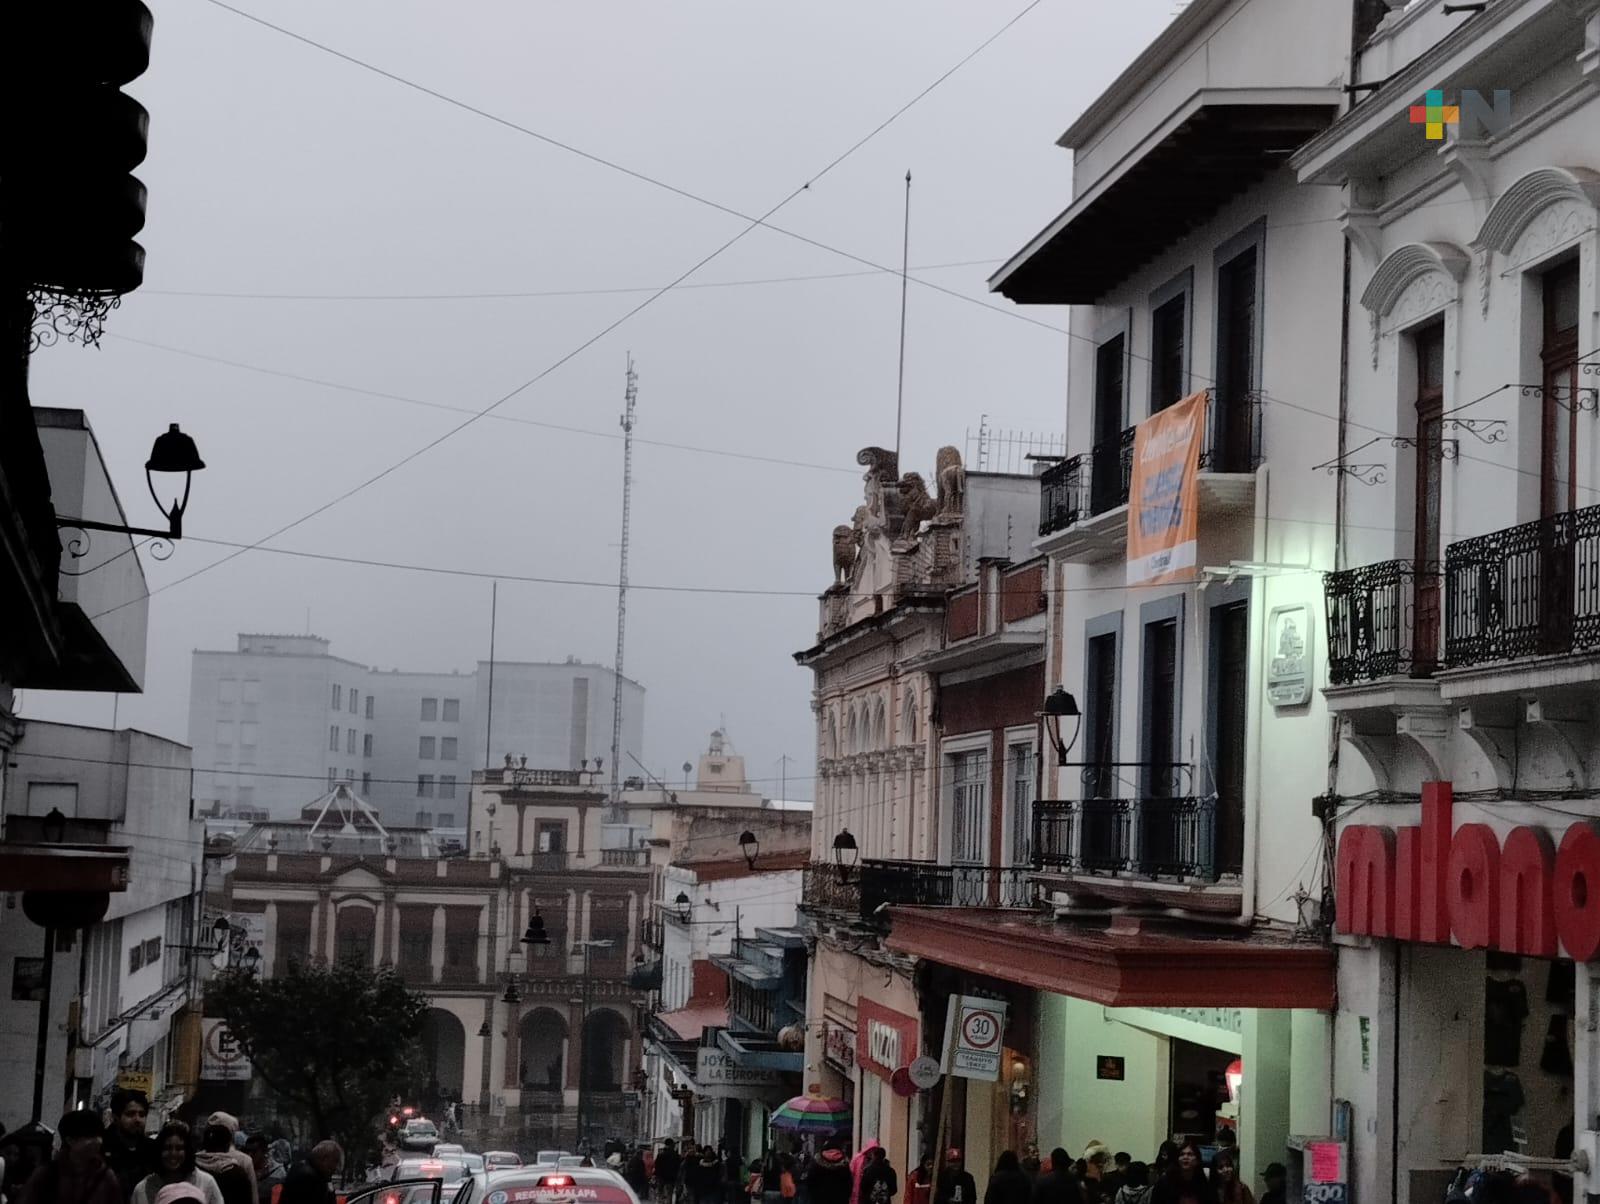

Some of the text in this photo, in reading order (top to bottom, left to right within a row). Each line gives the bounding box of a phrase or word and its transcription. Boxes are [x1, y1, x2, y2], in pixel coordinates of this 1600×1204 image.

[1334, 781, 1600, 962] milano
[971, 1018, 990, 1035] 30
[709, 1069, 722, 1079] LA
[556, 1188, 598, 1199] XALAPA
